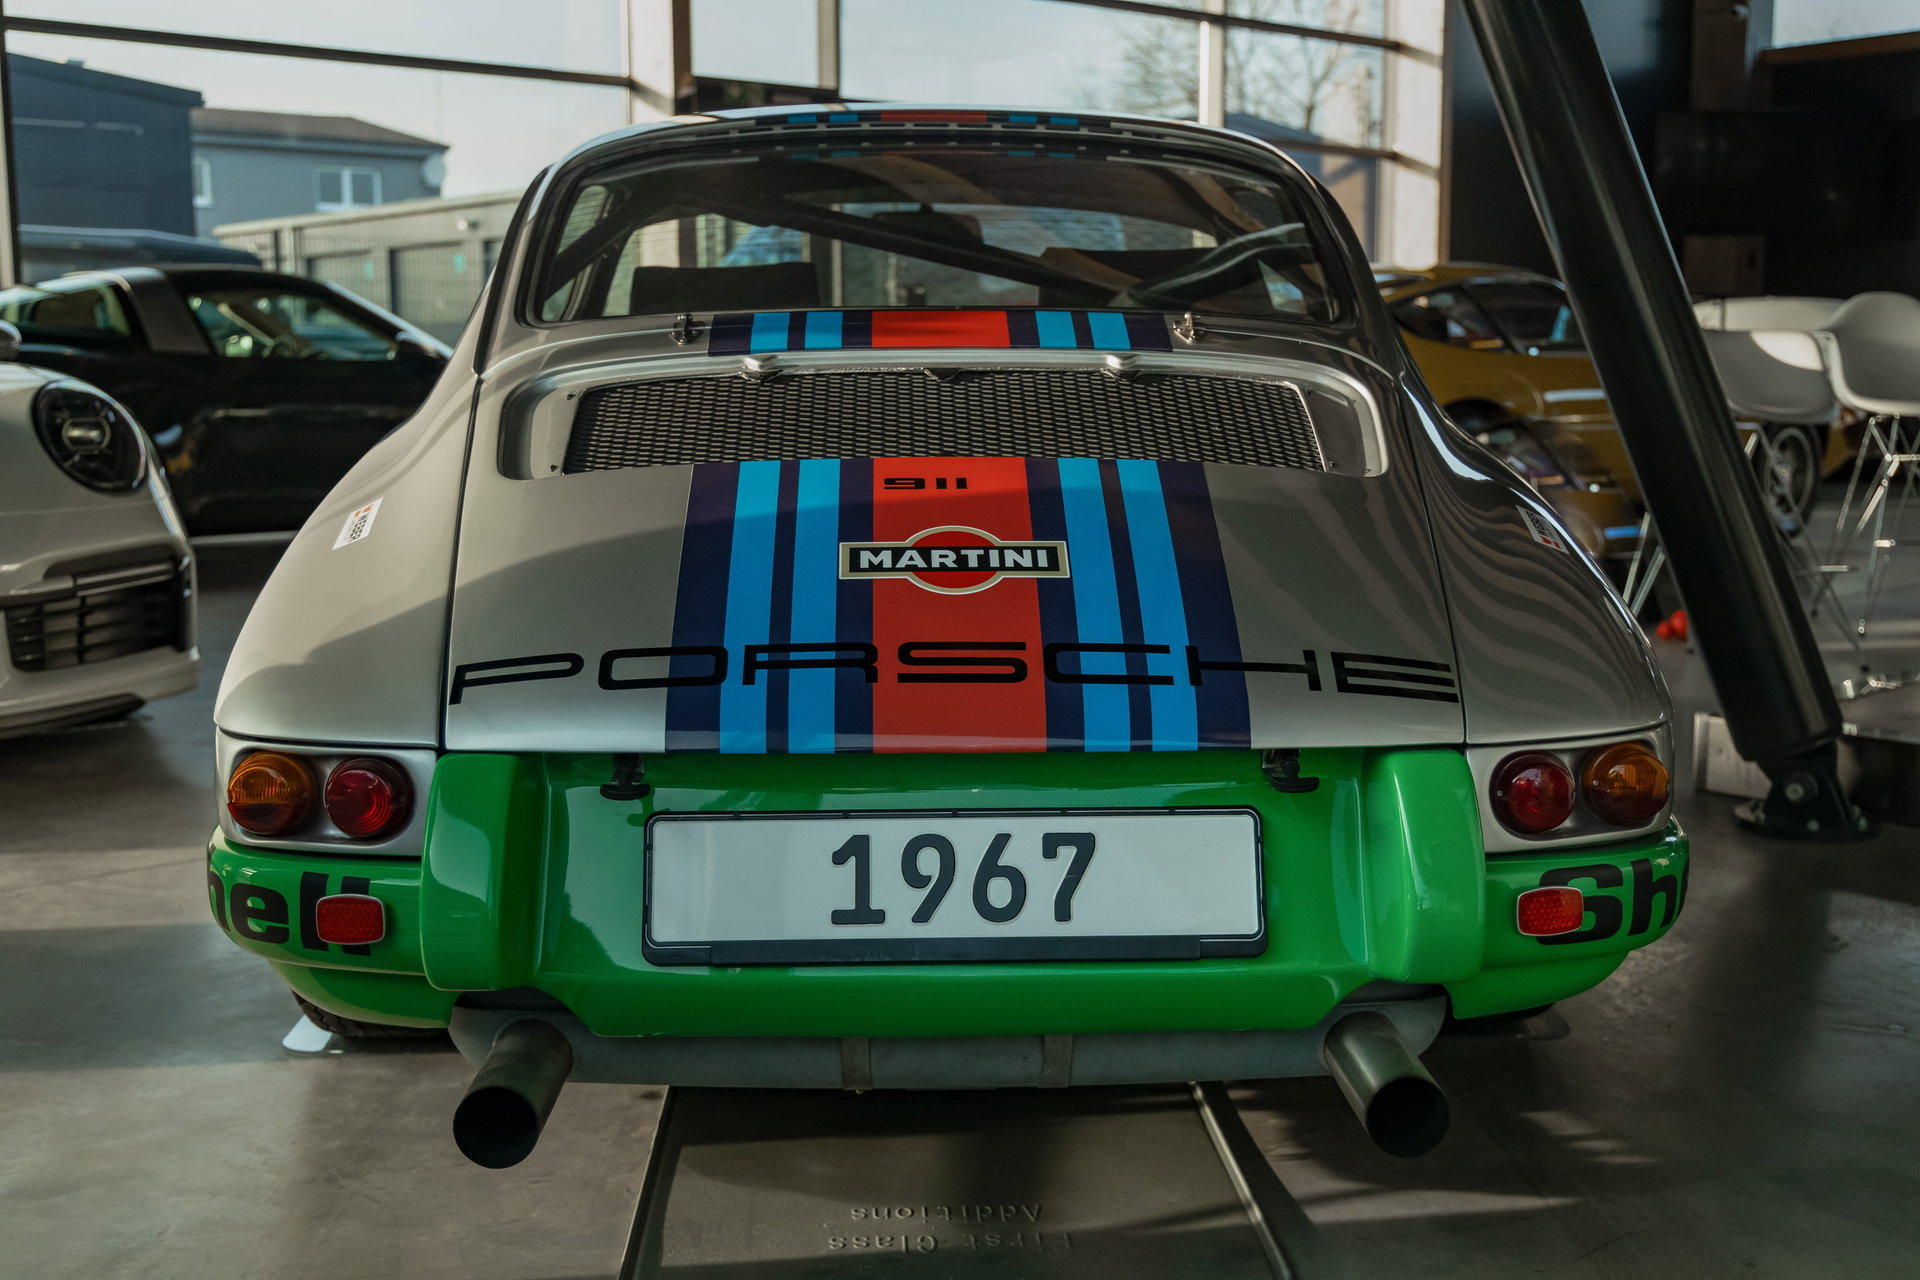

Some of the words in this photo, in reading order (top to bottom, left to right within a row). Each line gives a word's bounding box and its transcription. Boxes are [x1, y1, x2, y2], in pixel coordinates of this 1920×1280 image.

[884, 477, 968, 490] 911
[859, 549, 1049, 569] MARTINI
[448, 640, 1460, 706] PORSCHE
[830, 832, 1096, 926] 1967
[851, 1203, 1042, 1224] Additions
[828, 1233, 938, 1254] Class
[963, 1231, 1073, 1252] First
